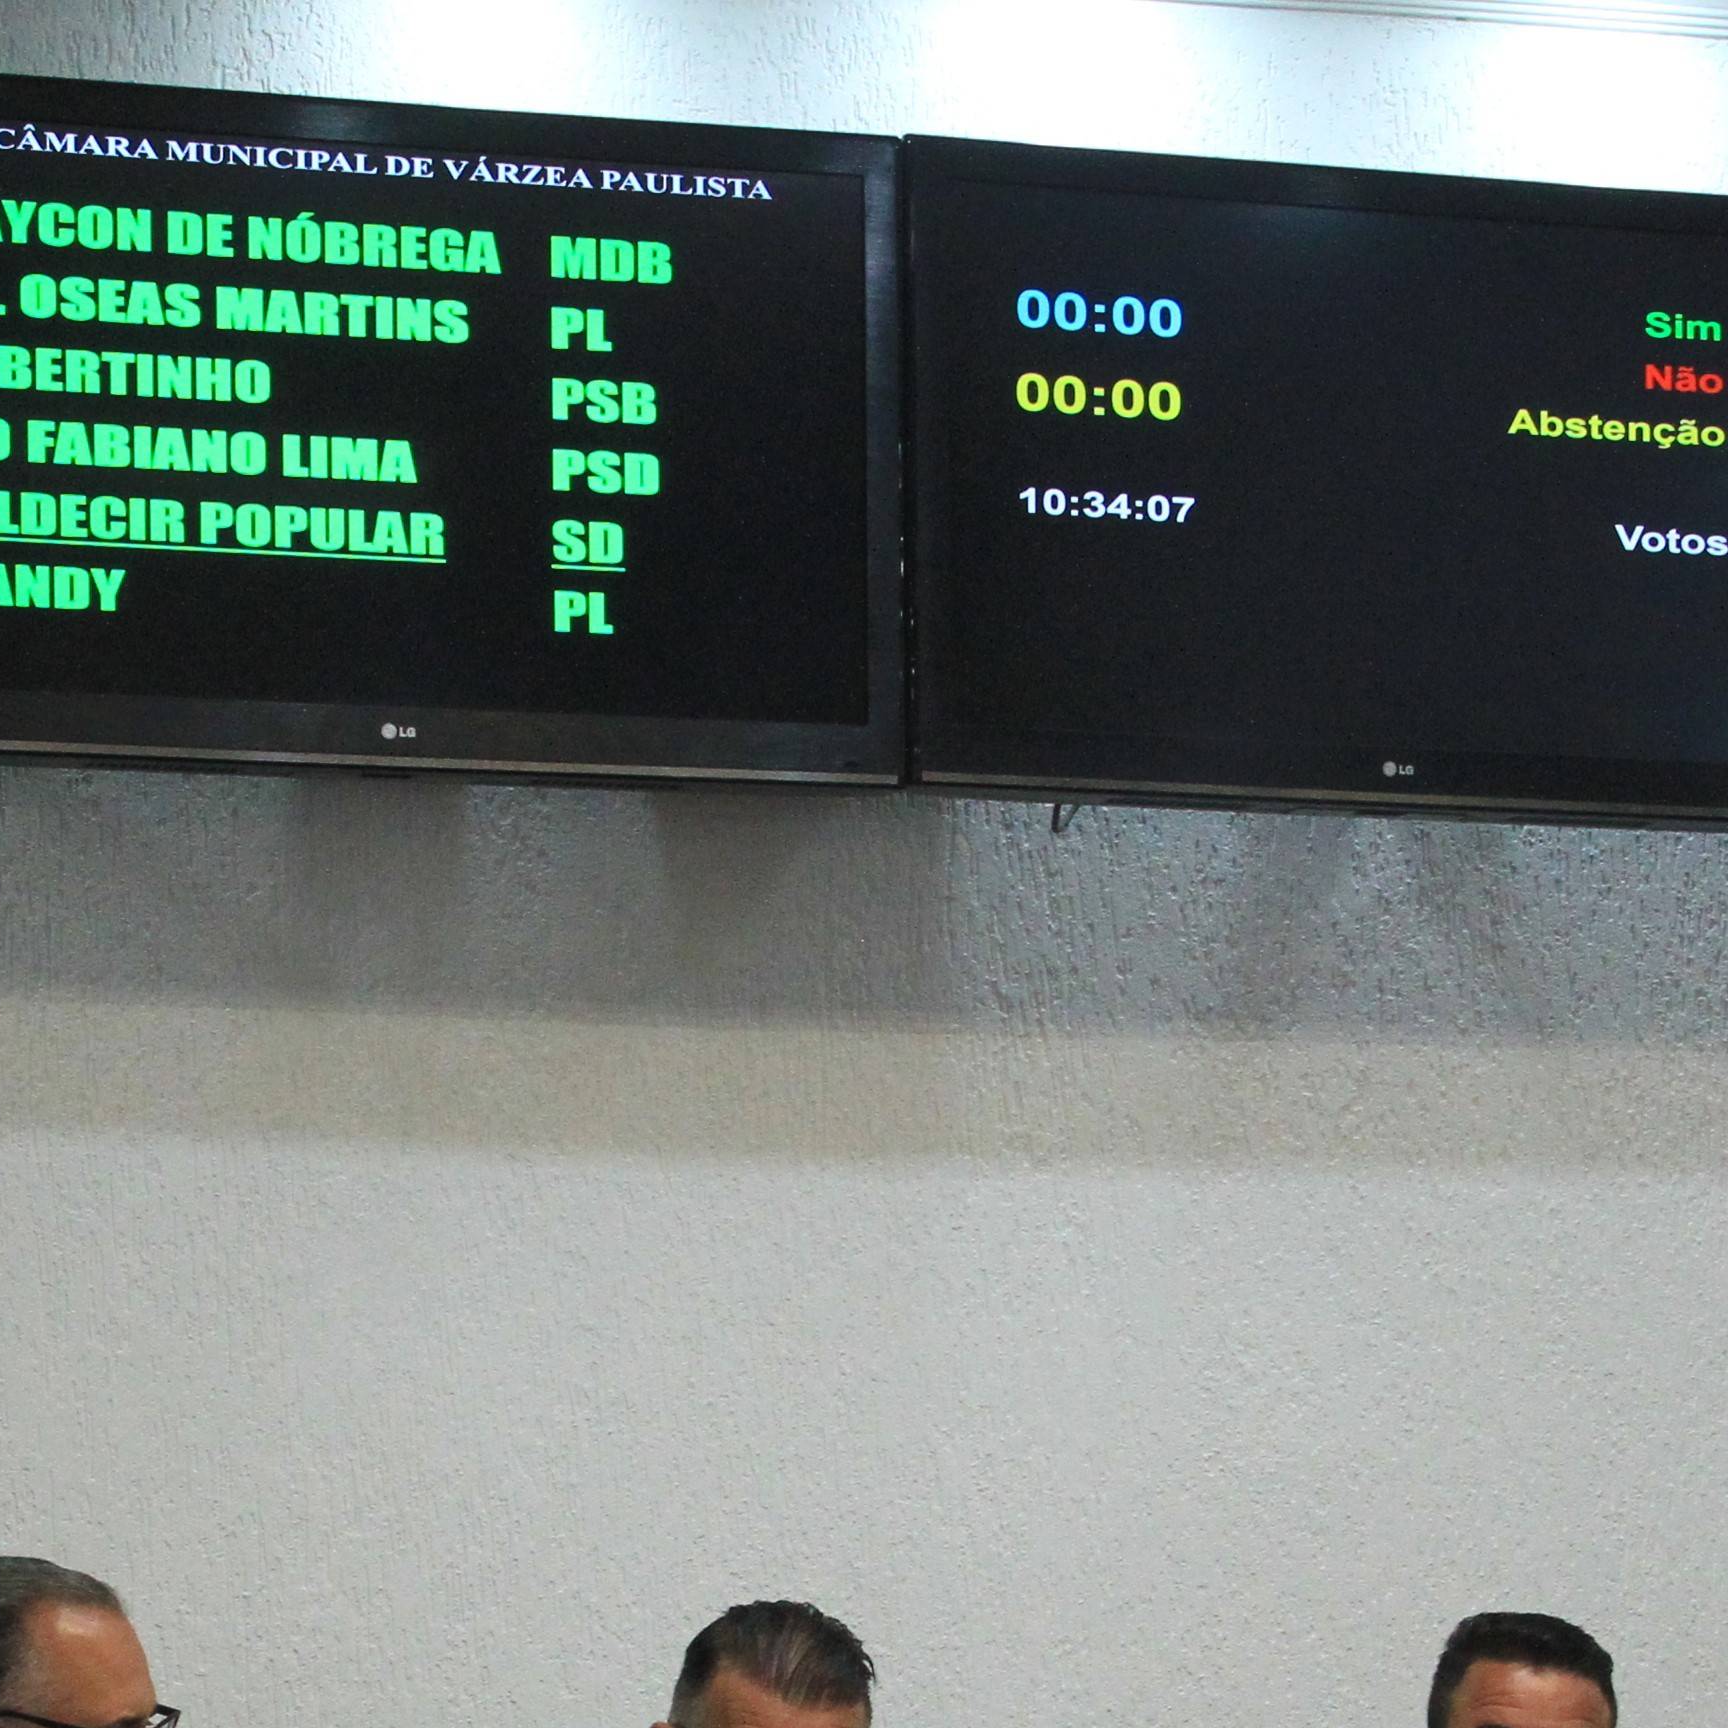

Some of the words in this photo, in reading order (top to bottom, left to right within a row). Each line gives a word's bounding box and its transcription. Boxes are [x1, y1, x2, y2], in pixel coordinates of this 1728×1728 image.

[165, 139, 378, 175] MUNICIPAL
[385, 155, 435, 179] DE
[442, 156, 594, 190] VÁRZEA
[599, 169, 773, 201] PAULISTA
[166, 210, 235, 257] DE
[247, 211, 503, 274] NÓBREGA
[550, 235, 673, 284] MDB
[19, 273, 202, 327] OSEAS
[215, 285, 470, 343] MARTINS
[550, 306, 613, 352] PL
[1015, 288, 1184, 339] 00:00
[1644, 311, 1722, 342] Sim
[551, 377, 658, 425] PSB
[1015, 372, 1182, 421] 00:00
[1644, 363, 1725, 396] Não
[26, 419, 268, 475] FABIANO
[281, 433, 418, 483] LIMA
[1507, 408, 1726, 450] Abstenção
[551, 448, 661, 495] PSD
[199, 500, 445, 556] POPULAR
[1019, 486, 1196, 523] 10:34:07
[551, 518, 625, 564] SD
[553, 589, 615, 634] PL
[398, 726, 417, 738] LG
[1398, 764, 1415, 775] LG
